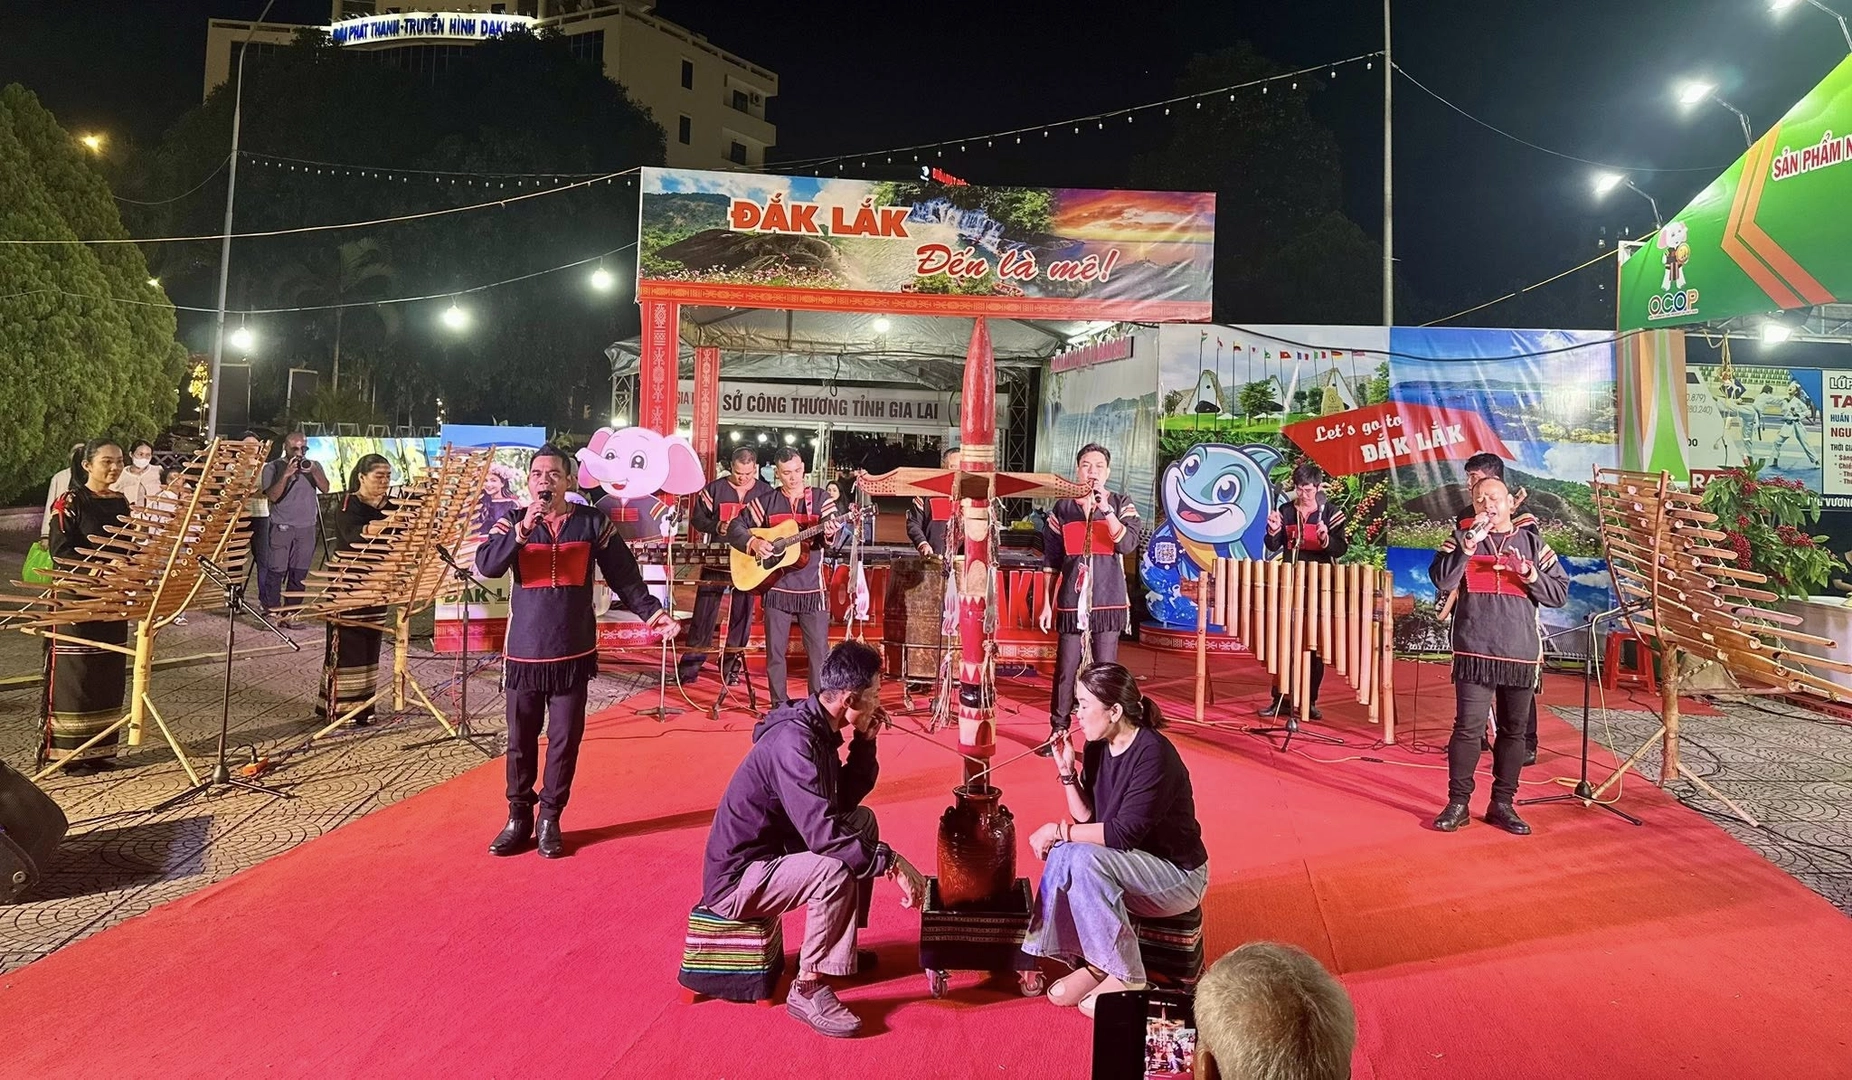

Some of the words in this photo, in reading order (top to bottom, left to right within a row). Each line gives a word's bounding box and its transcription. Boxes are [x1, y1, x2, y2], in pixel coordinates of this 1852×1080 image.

[349, 20, 369, 41] PHÁT
[449, 14, 476, 36] HÌNH
[1774, 147, 1798, 178] SẢN
[1803, 133, 1841, 170] PHẨM
[729, 192, 819, 234] ĐẮK
[832, 197, 911, 239] LẮK
[916, 243, 987, 278] Đến
[1000, 246, 1037, 280] là
[1047, 249, 1119, 282] mê!
[1649, 289, 1698, 315] OCOP
[722, 389, 743, 412] SỞ
[747, 392, 787, 414] CÔNG
[791, 396, 848, 416] THƯƠNG
[852, 394, 885, 418] TỈNH
[889, 400, 912, 419] GIA
[917, 402, 938, 420] LAI
[1315, 422, 1356, 443] Let's
[1362, 419, 1383, 435] go
[1386, 414, 1404, 427] to
[1360, 434, 1411, 463] ĐẮK
[1415, 421, 1465, 451] LẮK
